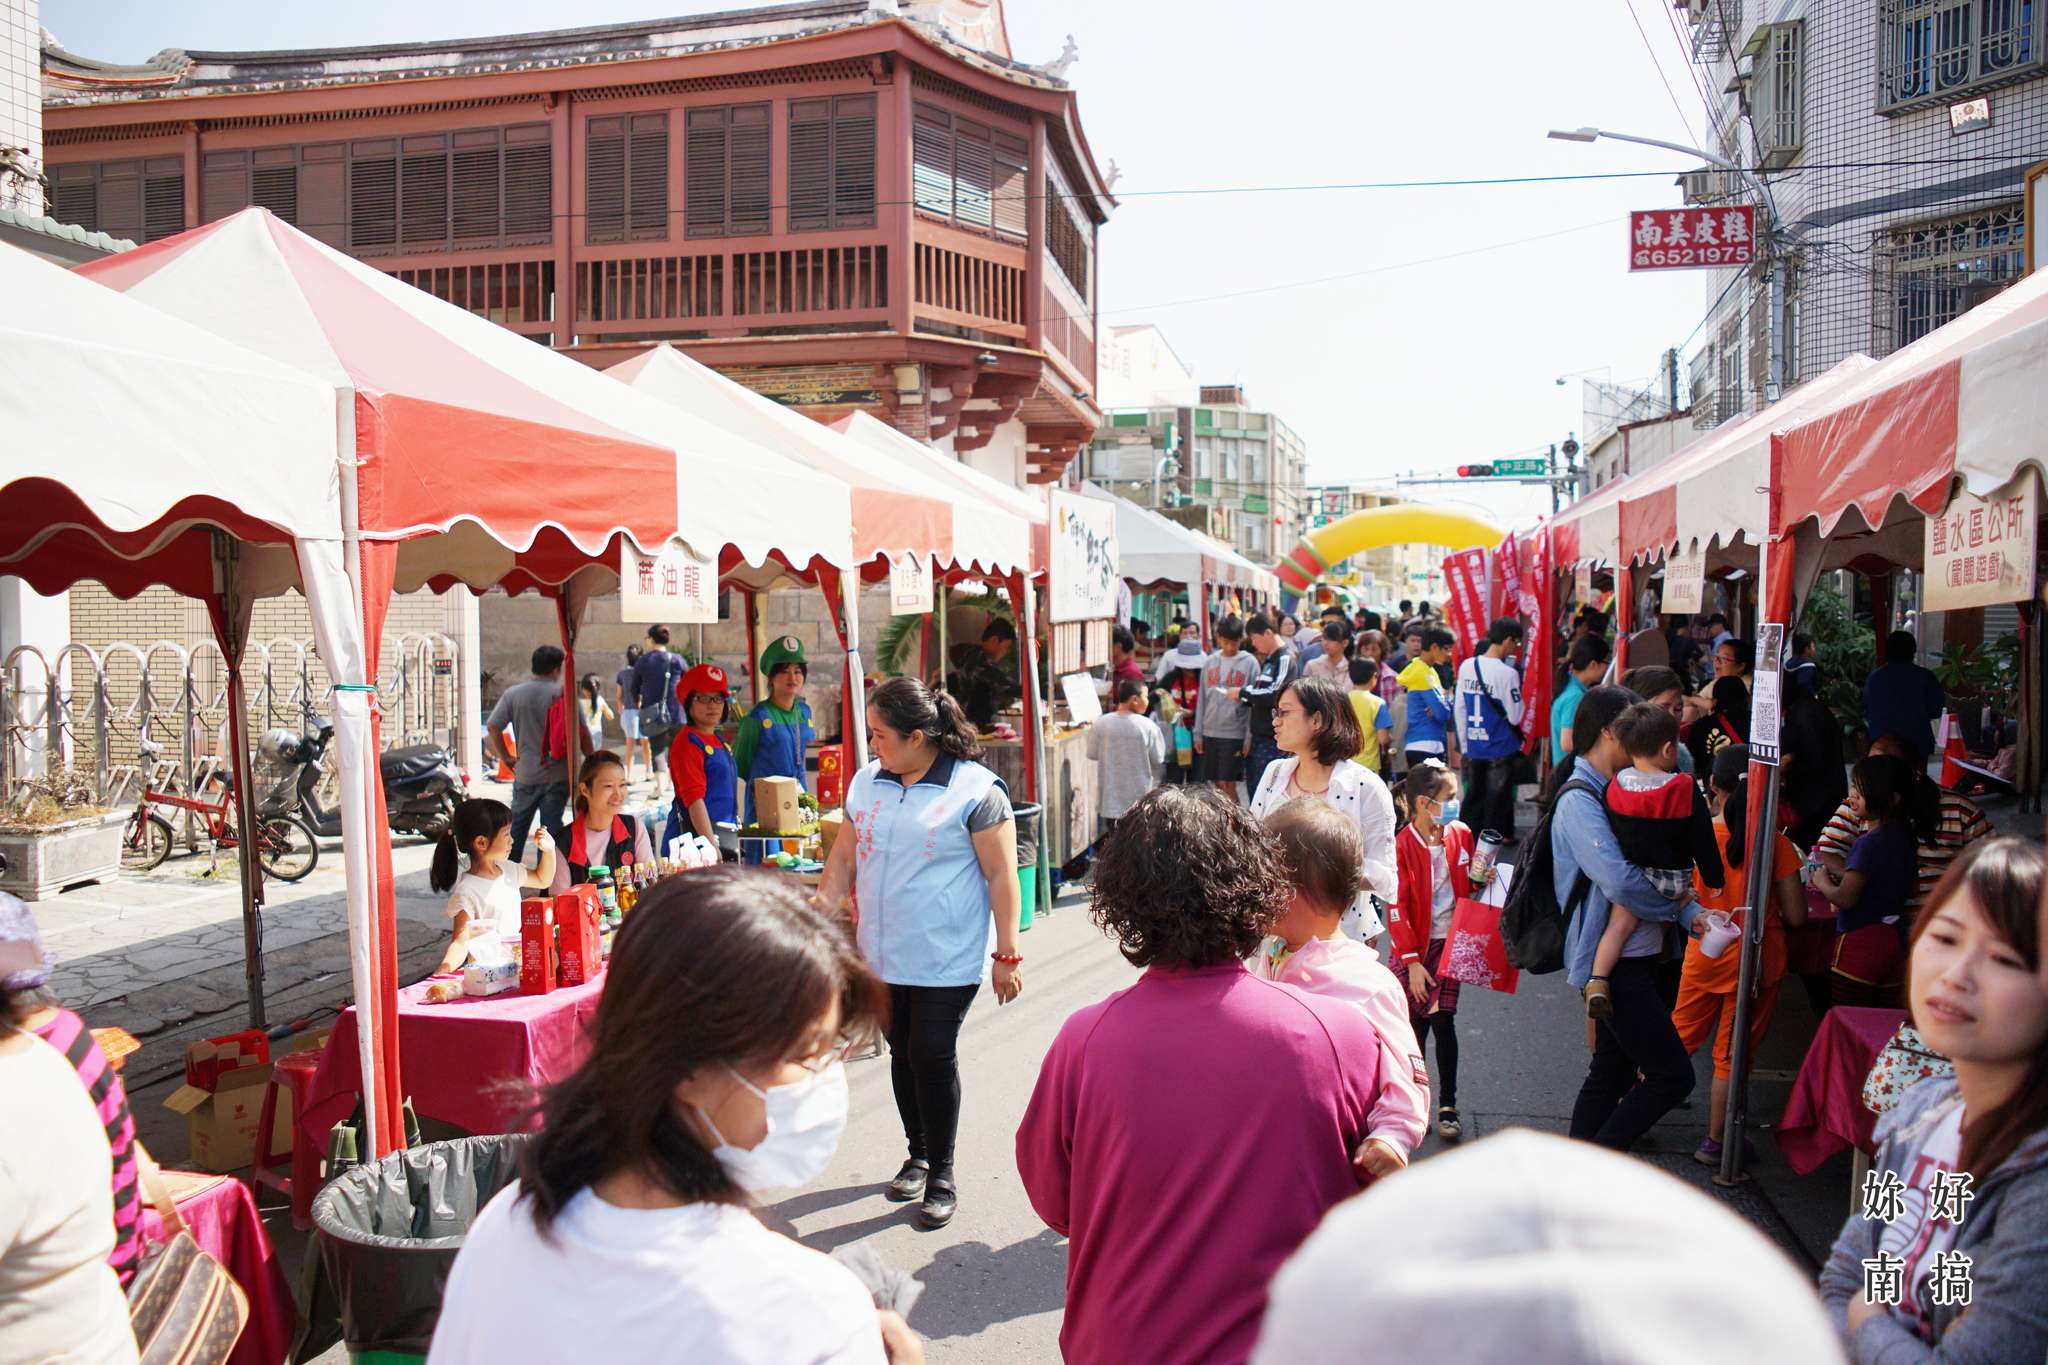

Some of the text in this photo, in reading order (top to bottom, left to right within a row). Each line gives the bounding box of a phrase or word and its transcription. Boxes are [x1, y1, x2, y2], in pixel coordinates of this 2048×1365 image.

[1635, 211, 1750, 248] 南美皮鞋
[1651, 246, 1750, 265] 6521975
[1932, 495, 2024, 556] 鹽水區公所
